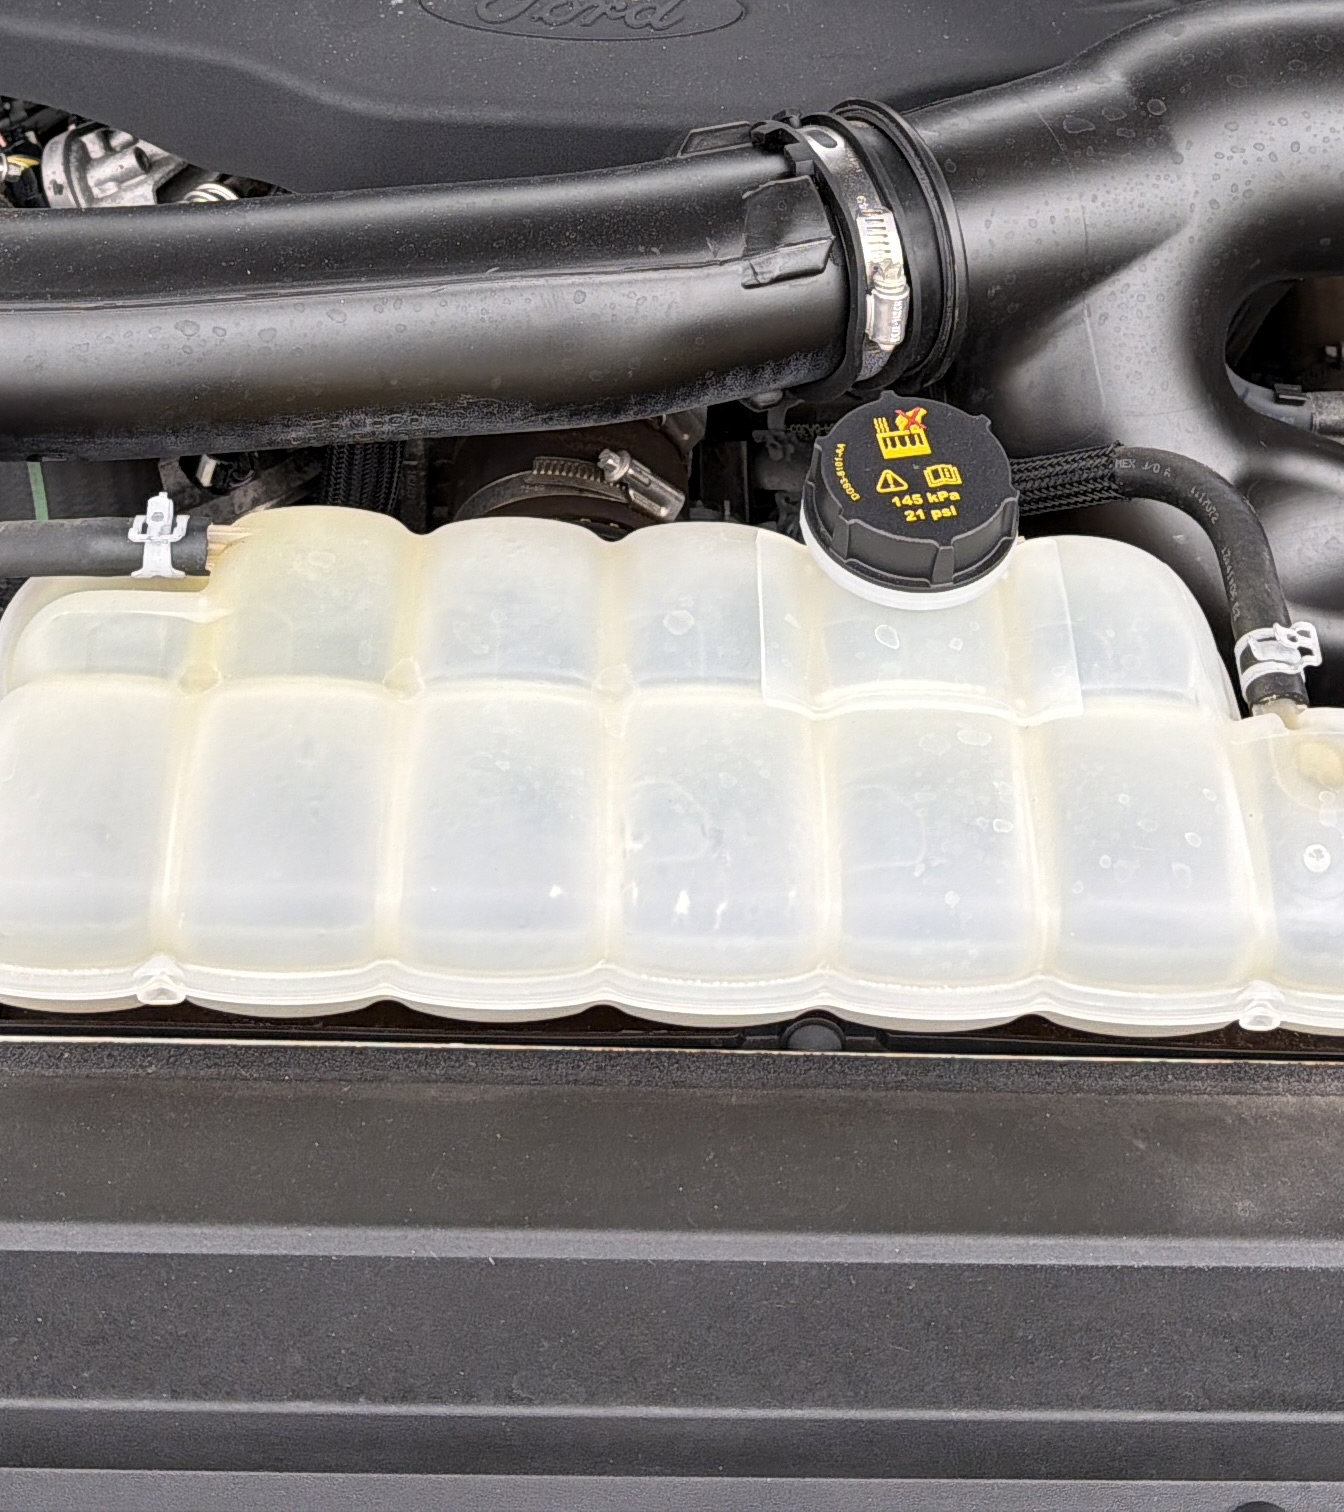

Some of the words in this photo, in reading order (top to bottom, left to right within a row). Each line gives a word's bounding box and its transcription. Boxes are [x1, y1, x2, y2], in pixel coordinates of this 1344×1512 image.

[892, 492, 924, 508] 145
[927, 491, 961, 504] kPa
[904, 511, 926, 523] 21
[932, 507, 958, 522] psi
